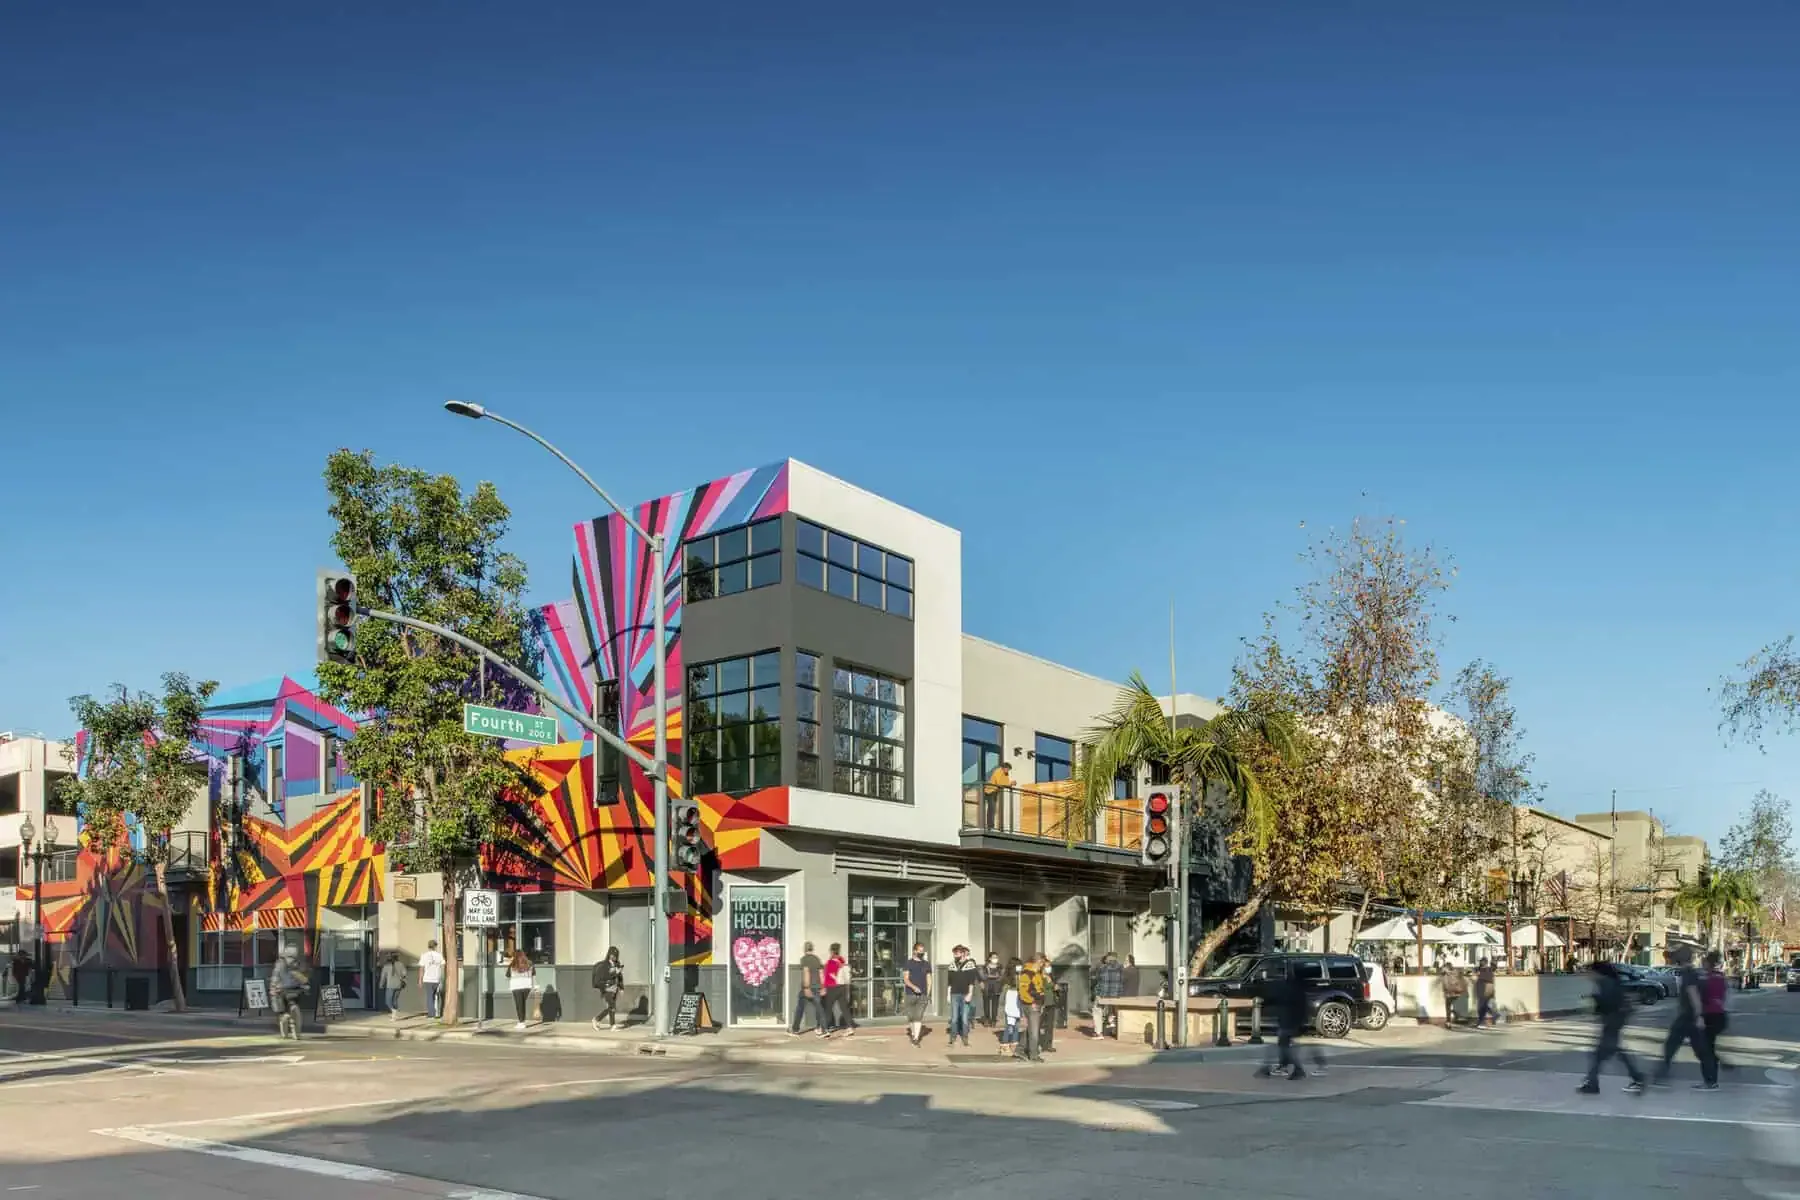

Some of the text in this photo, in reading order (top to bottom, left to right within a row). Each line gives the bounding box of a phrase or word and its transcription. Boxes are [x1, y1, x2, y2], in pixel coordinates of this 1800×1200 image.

[471, 711, 524, 733] Fourth
[528, 729, 545, 739] 200
[734, 912, 782, 929] HELLO!
